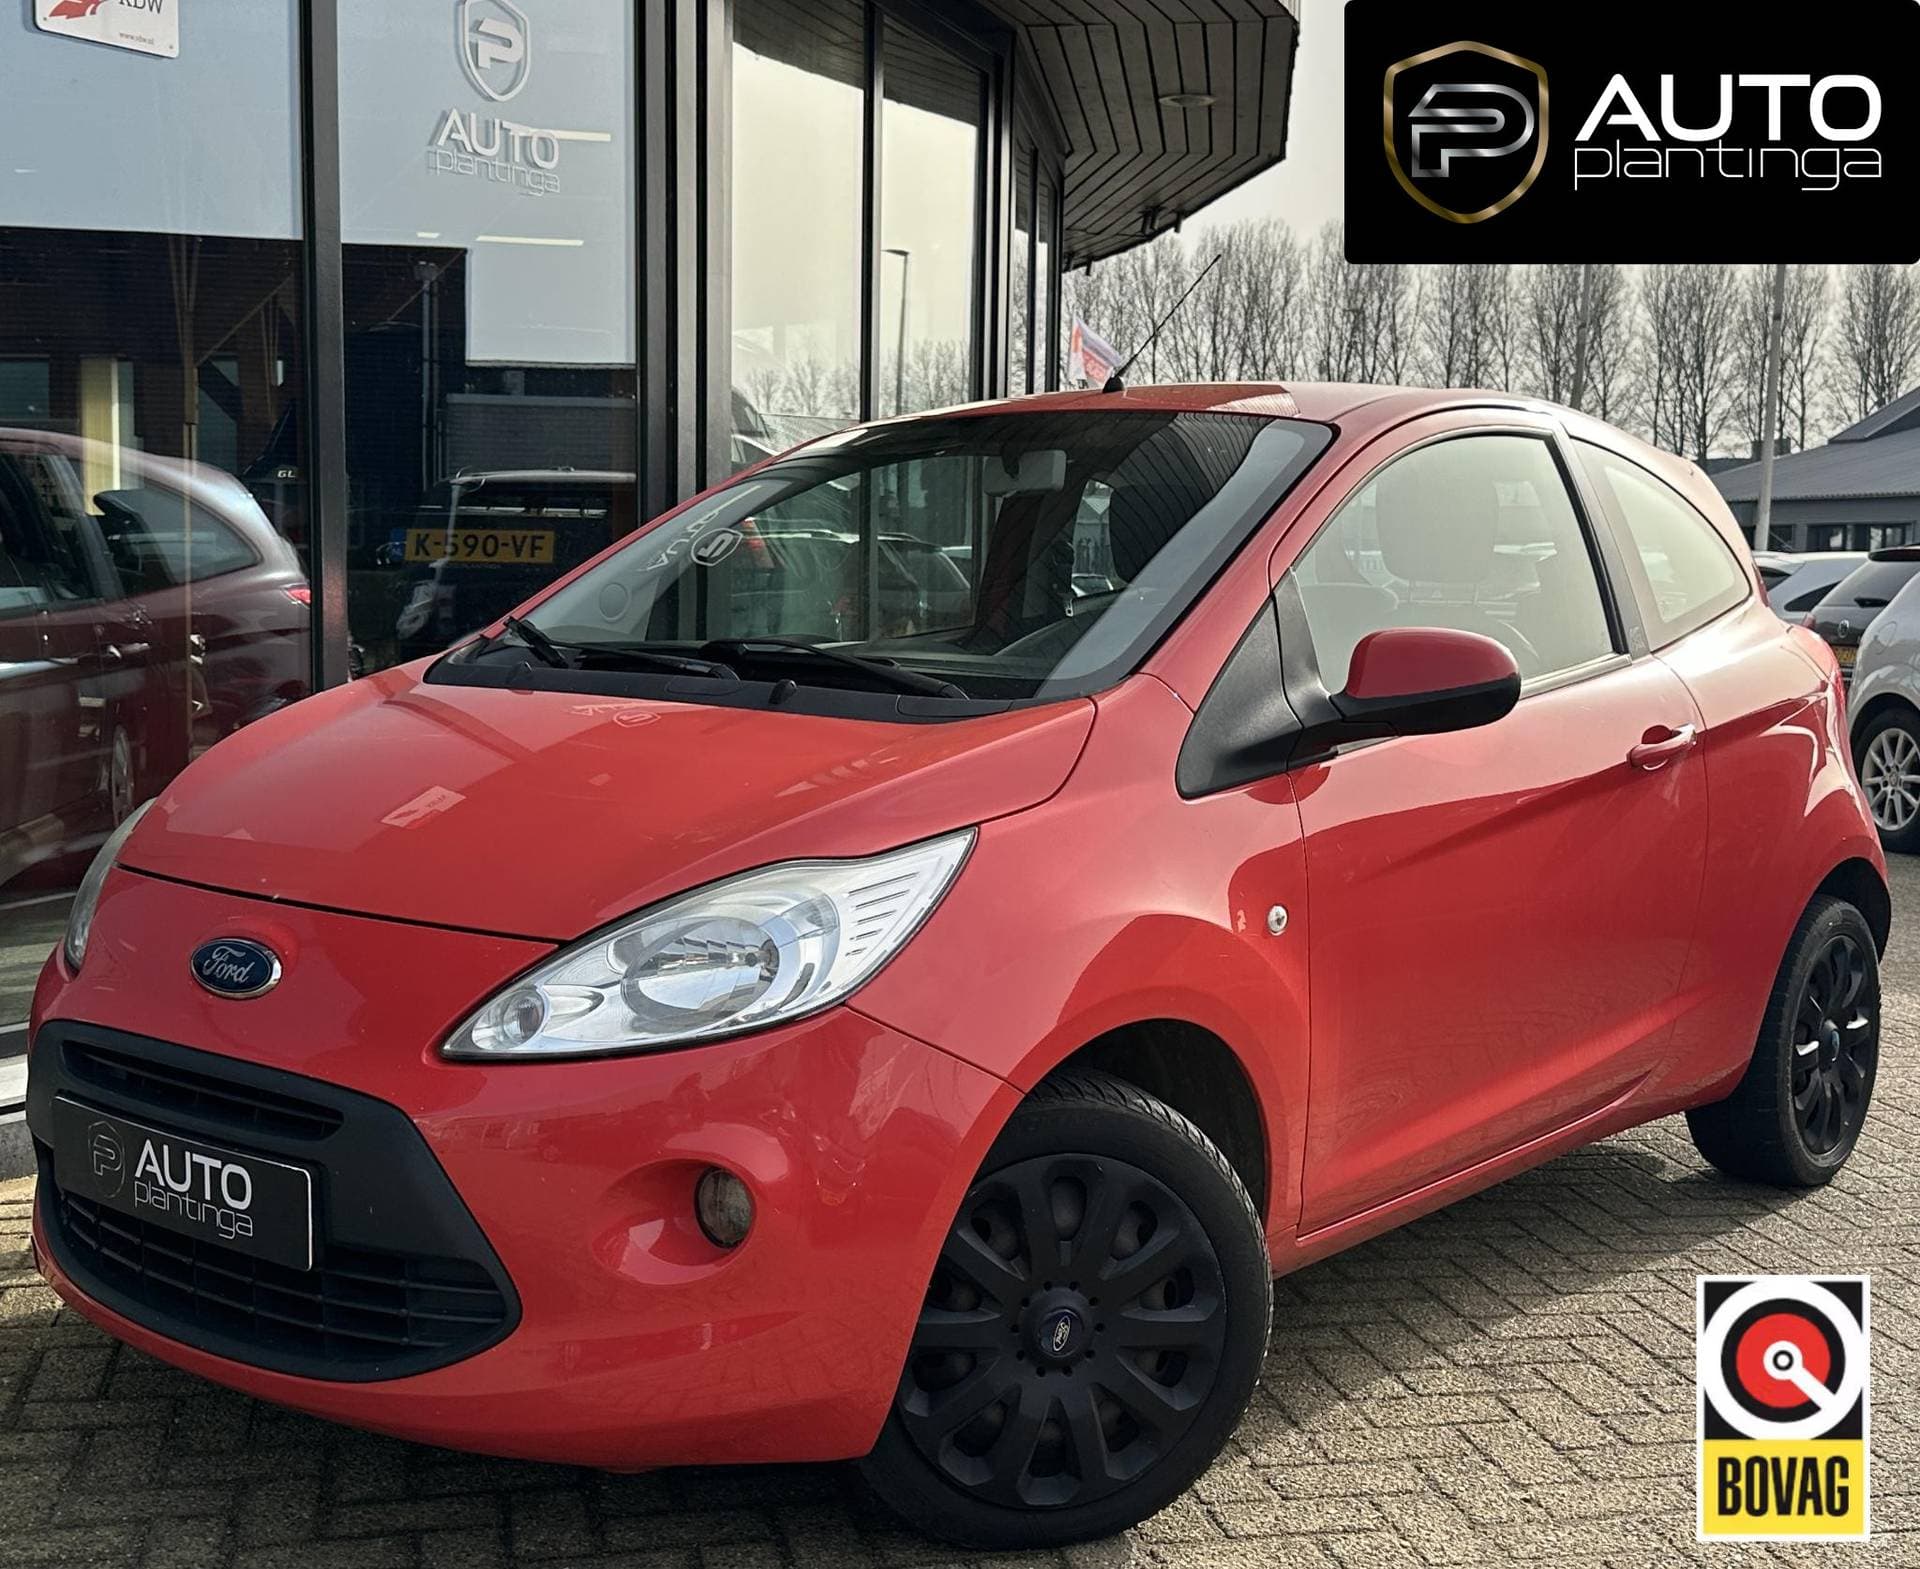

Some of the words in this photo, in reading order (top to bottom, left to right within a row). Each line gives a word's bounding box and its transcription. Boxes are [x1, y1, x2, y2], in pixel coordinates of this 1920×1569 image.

[436, 107, 560, 170] AUTO
[435, 147, 561, 197] plantinga
[414, 532, 546, 558] K-590-VF
[202, 945, 256, 983] Ford
[134, 1139, 253, 1211] AUTO
[133, 1180, 253, 1240] plantinga
